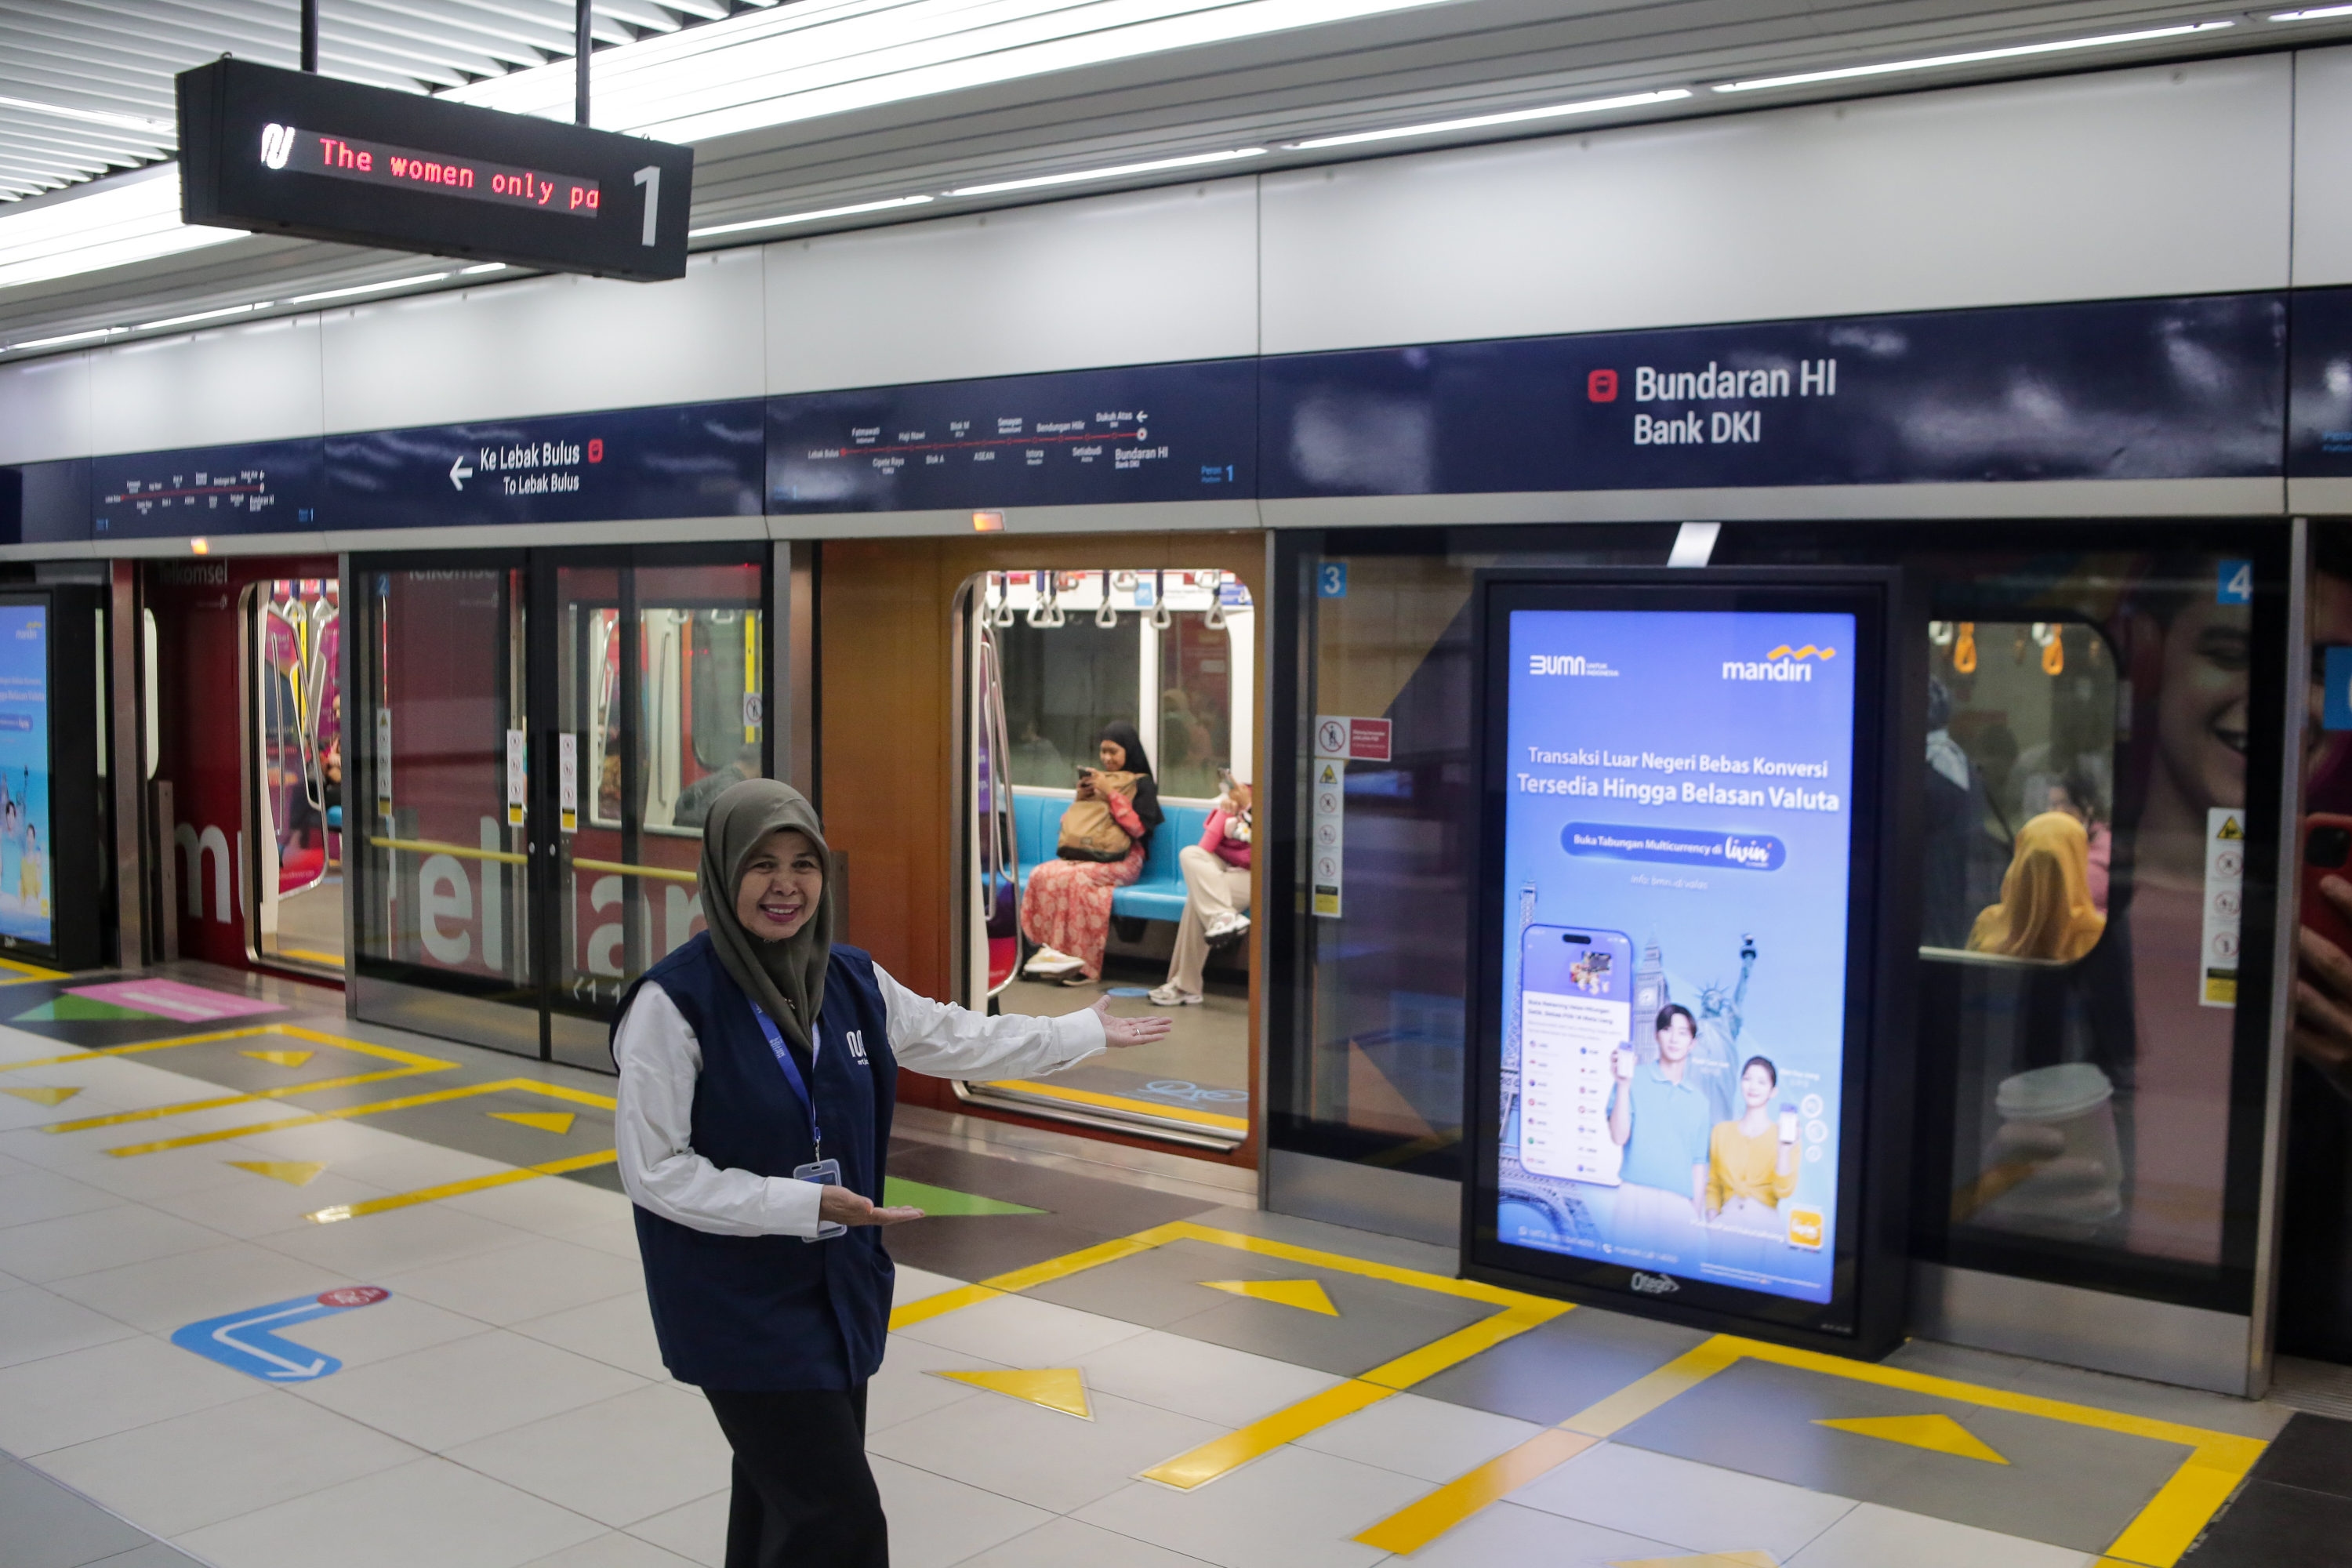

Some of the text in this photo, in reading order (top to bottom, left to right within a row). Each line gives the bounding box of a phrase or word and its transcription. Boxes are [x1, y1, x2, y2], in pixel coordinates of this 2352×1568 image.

[320, 137, 599, 210] The women only pa
[633, 165, 660, 247] 1
[1635, 358, 1837, 402] Bundaran HI
[1634, 410, 1762, 445] Bank DKI
[480, 440, 580, 471] Ke Lebak Bulus
[1115, 445, 1169, 461] Bundaran HI
[503, 471, 579, 495] To Lebak Bulus
[1225, 465, 1234, 482] 1
[1323, 564, 1341, 594] 3
[2227, 564, 2252, 601] 4
[1722, 657, 1812, 681] mandiri
[1528, 746, 1828, 779] Transaksi Luar Negeri Bebas Konversi
[1517, 773, 1840, 812] Tersedia Hingga Belasan Valuta
[1573, 833, 1597, 846] Buka
[1598, 835, 1644, 851] Tabungan
[1645, 839, 1711, 856] Multicurrency
[1711, 844, 1723, 855] di
